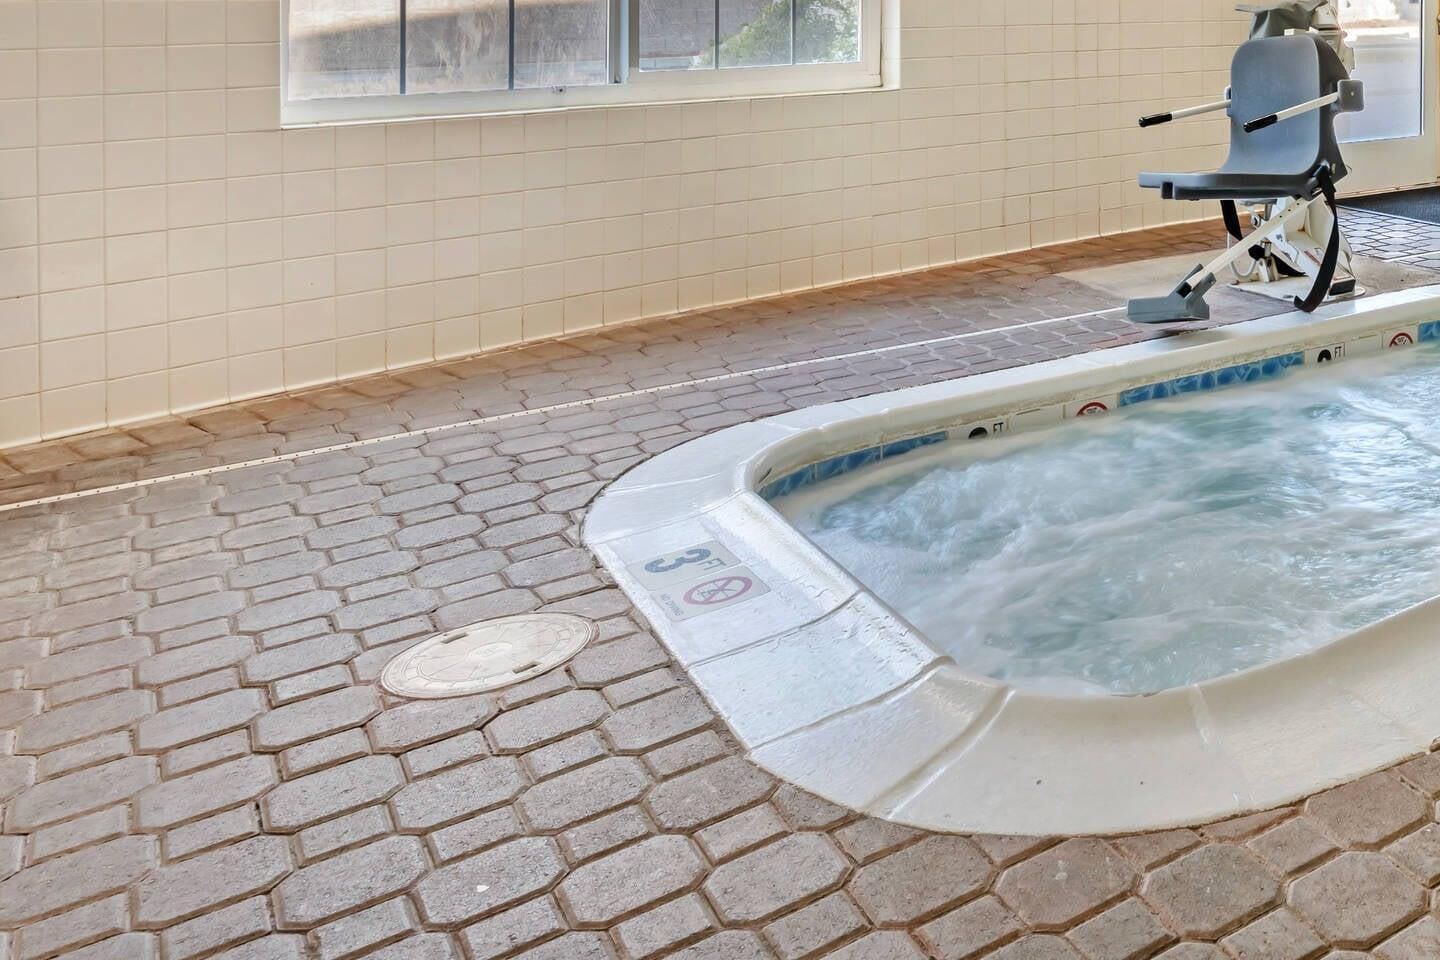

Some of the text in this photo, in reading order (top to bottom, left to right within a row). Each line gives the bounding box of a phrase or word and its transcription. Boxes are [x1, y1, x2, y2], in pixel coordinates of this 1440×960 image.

[1334, 346, 1342, 359] FT
[992, 422, 1004, 434] FT
[644, 548, 727, 574] 3 FT
